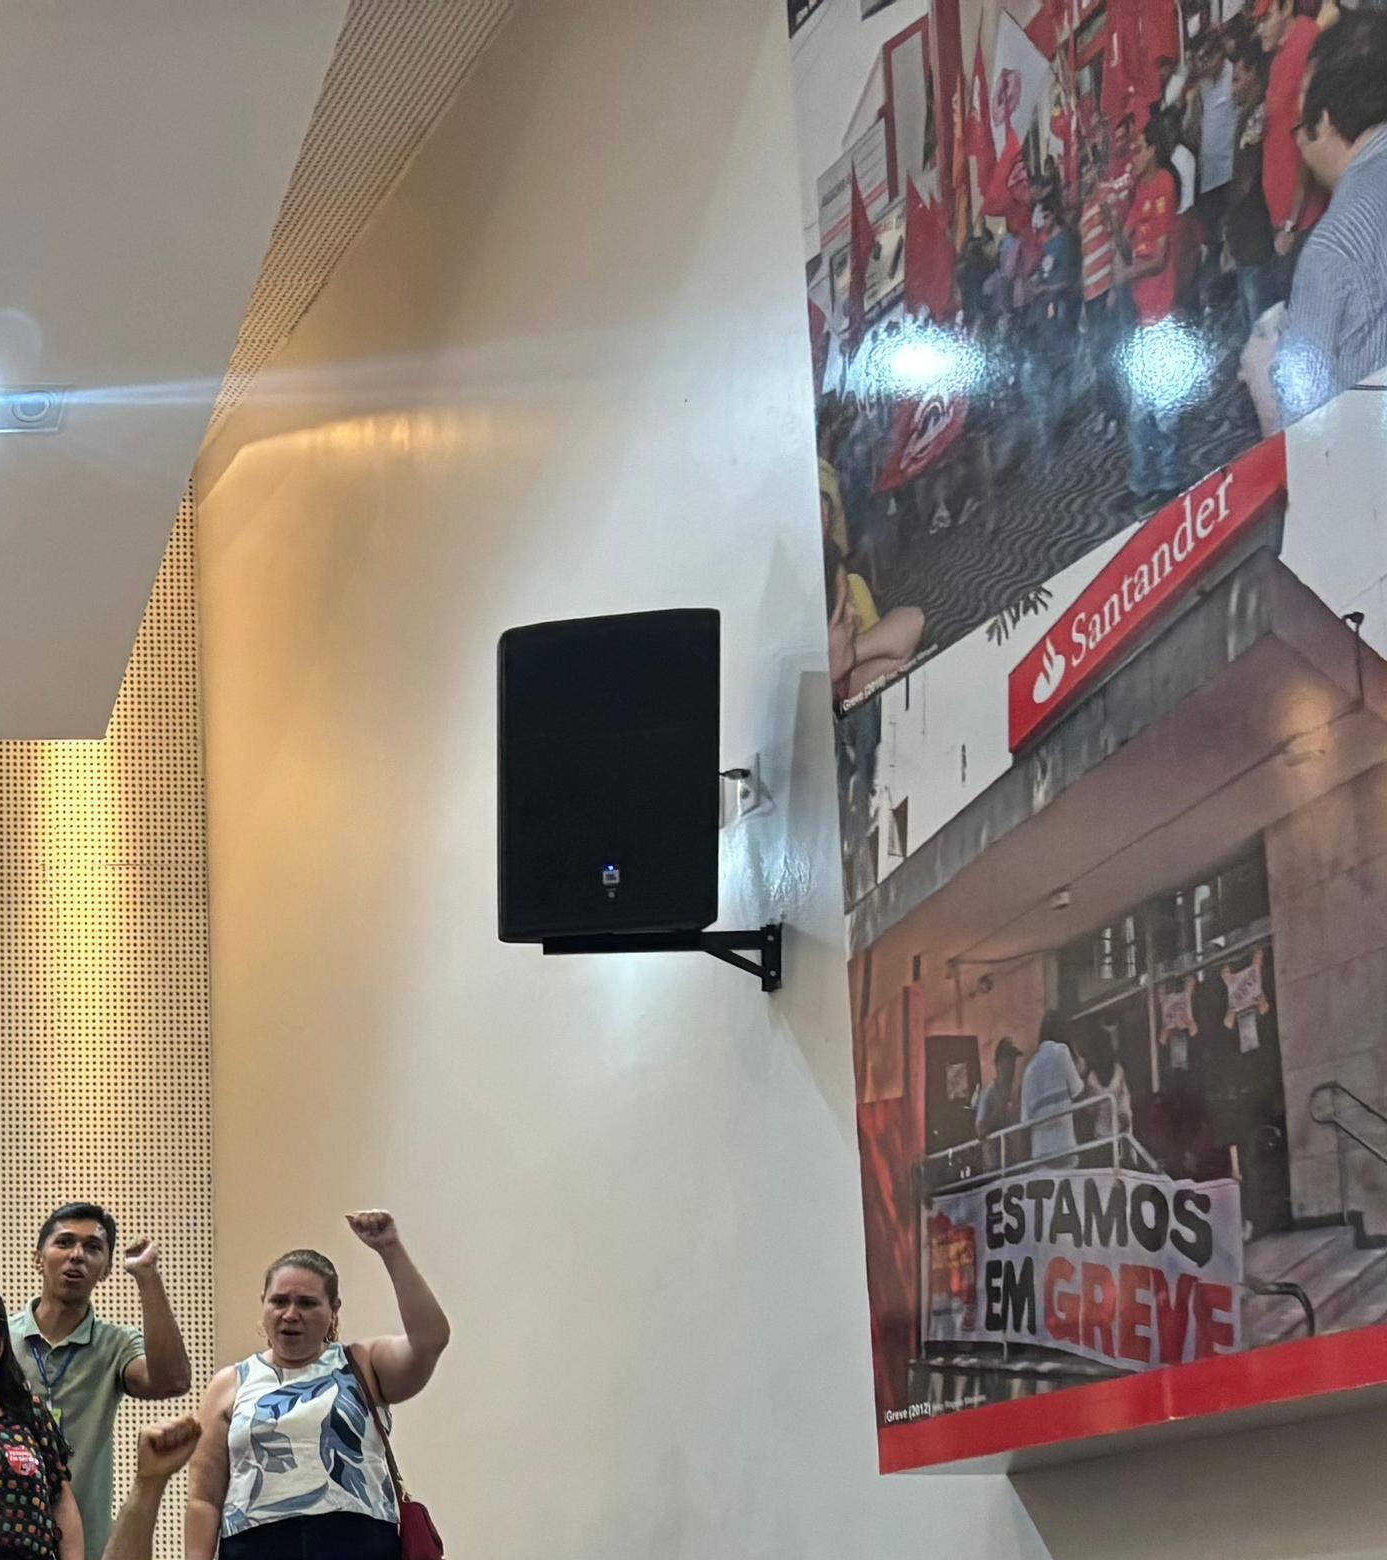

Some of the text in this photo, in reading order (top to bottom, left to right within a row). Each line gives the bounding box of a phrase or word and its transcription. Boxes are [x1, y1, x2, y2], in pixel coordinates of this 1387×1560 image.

[1071, 473, 1233, 667] Santander
[985, 1178, 1213, 1268] ESTAMOS
[985, 1256, 1235, 1370] EM GREVE
